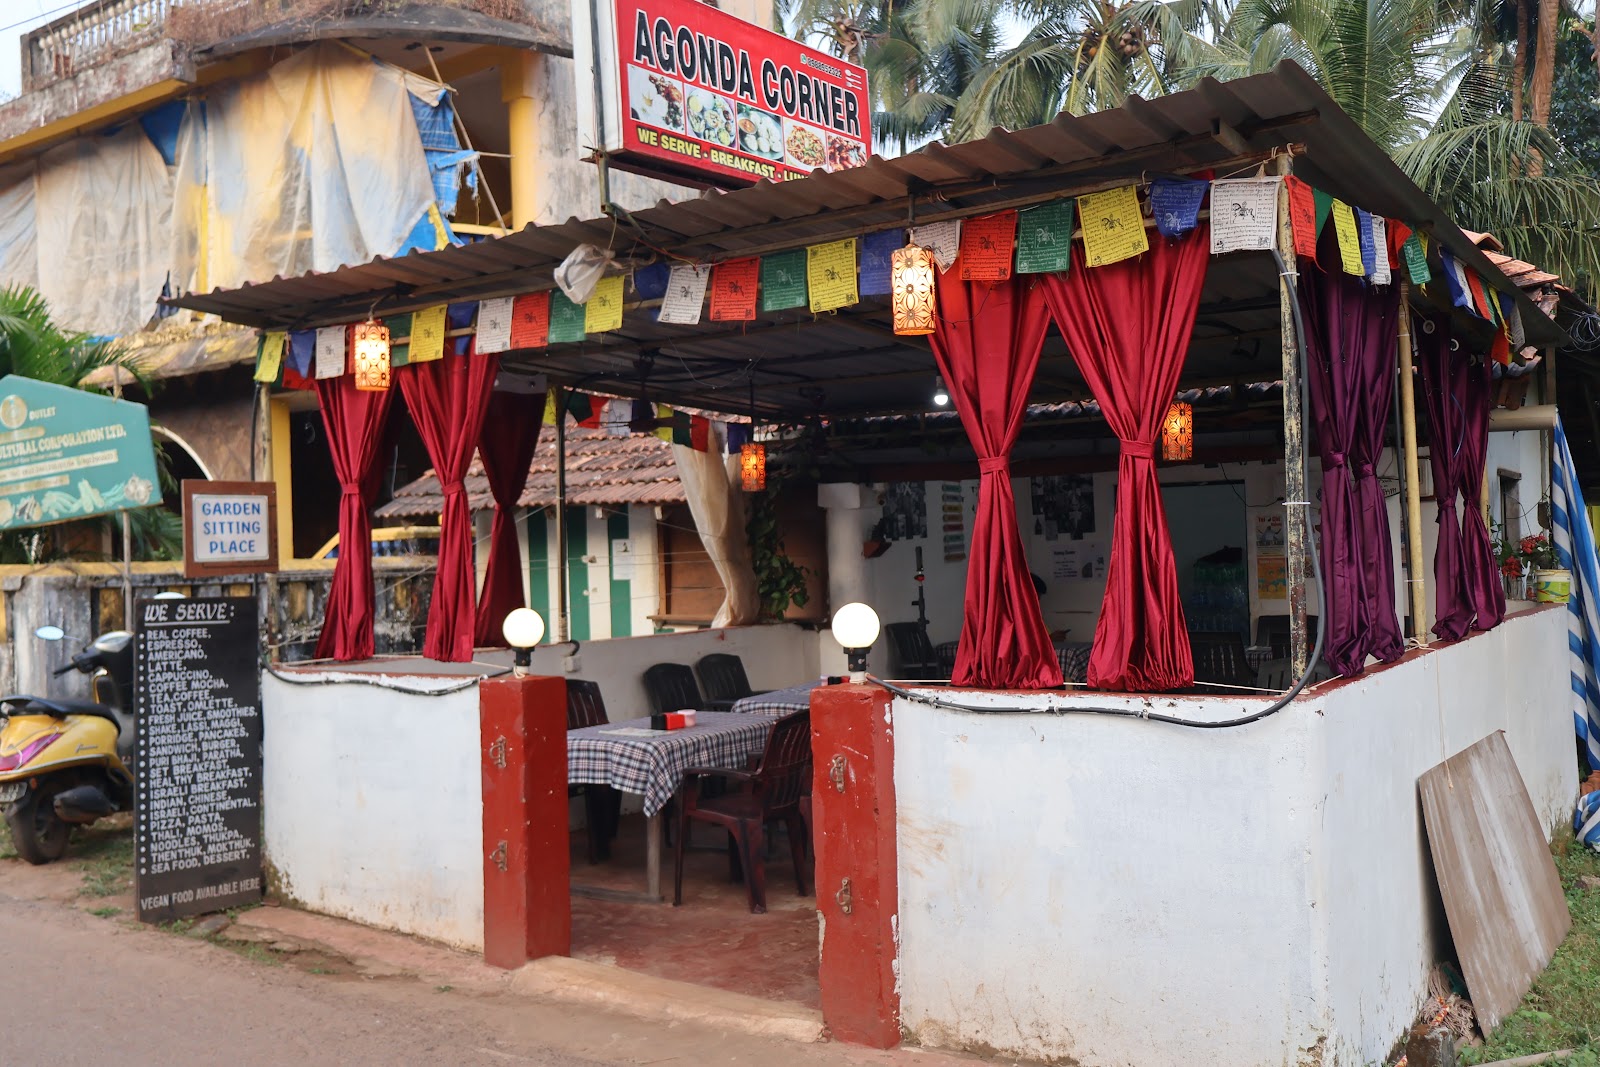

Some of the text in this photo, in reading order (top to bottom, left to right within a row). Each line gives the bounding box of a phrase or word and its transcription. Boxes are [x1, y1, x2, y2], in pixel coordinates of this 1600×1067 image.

[633, 9, 862, 138] AGONDA CORNER
[637, 126, 658, 147] WE
[660, 134, 701, 159] SERVE
[711, 150, 776, 178] BREAKFAST
[29, 406, 55, 420] OUTLET
[39, 426, 104, 451] CORPORATION
[106, 424, 126, 439] LTD.
[202, 502, 261, 516] GARDEN
[203, 522, 261, 535] SITTING
[209, 540, 255, 554] PLACE
[145, 604, 168, 622] WE
[147, 628, 211, 640] REAL COFFEE,
[147, 639, 202, 650] ESPRESSO,
[148, 650, 207, 661] AMERICANO,
[148, 661, 186, 672] LATTE,
[148, 670, 212, 682] CAPPUCCINO,
[149, 679, 229, 693] COFFEE MOCHA,
[150, 698, 237, 714] TOAST, OMLETTE,
[148, 714, 175, 725] FRESH
[150, 727, 249, 746] PORRIDGE, PANCAKES,
[202, 739, 240, 751] BURGER,
[150, 749, 244, 767] PURI BHAJI, PARATHA,
[150, 760, 229, 778] SET BREAKFAST,
[150, 767, 252, 788] HEALTHY BREAKFAST,
[150, 778, 247, 799] ISRAELI BREAKFAST,
[150, 790, 231, 810] INDIAN, CHINESE,
[190, 798, 256, 814] CONTINENTAL,
[150, 813, 224, 831] PIZZA, PASTA,
[151, 822, 227, 842] THALI, MOMOS,
[151, 830, 243, 852] NOODLES, THUKPA,
[151, 850, 249, 874] SEA FOOD, DESSERT,
[141, 878, 260, 910] VEGAN FOOD AVAILABLE HERE
